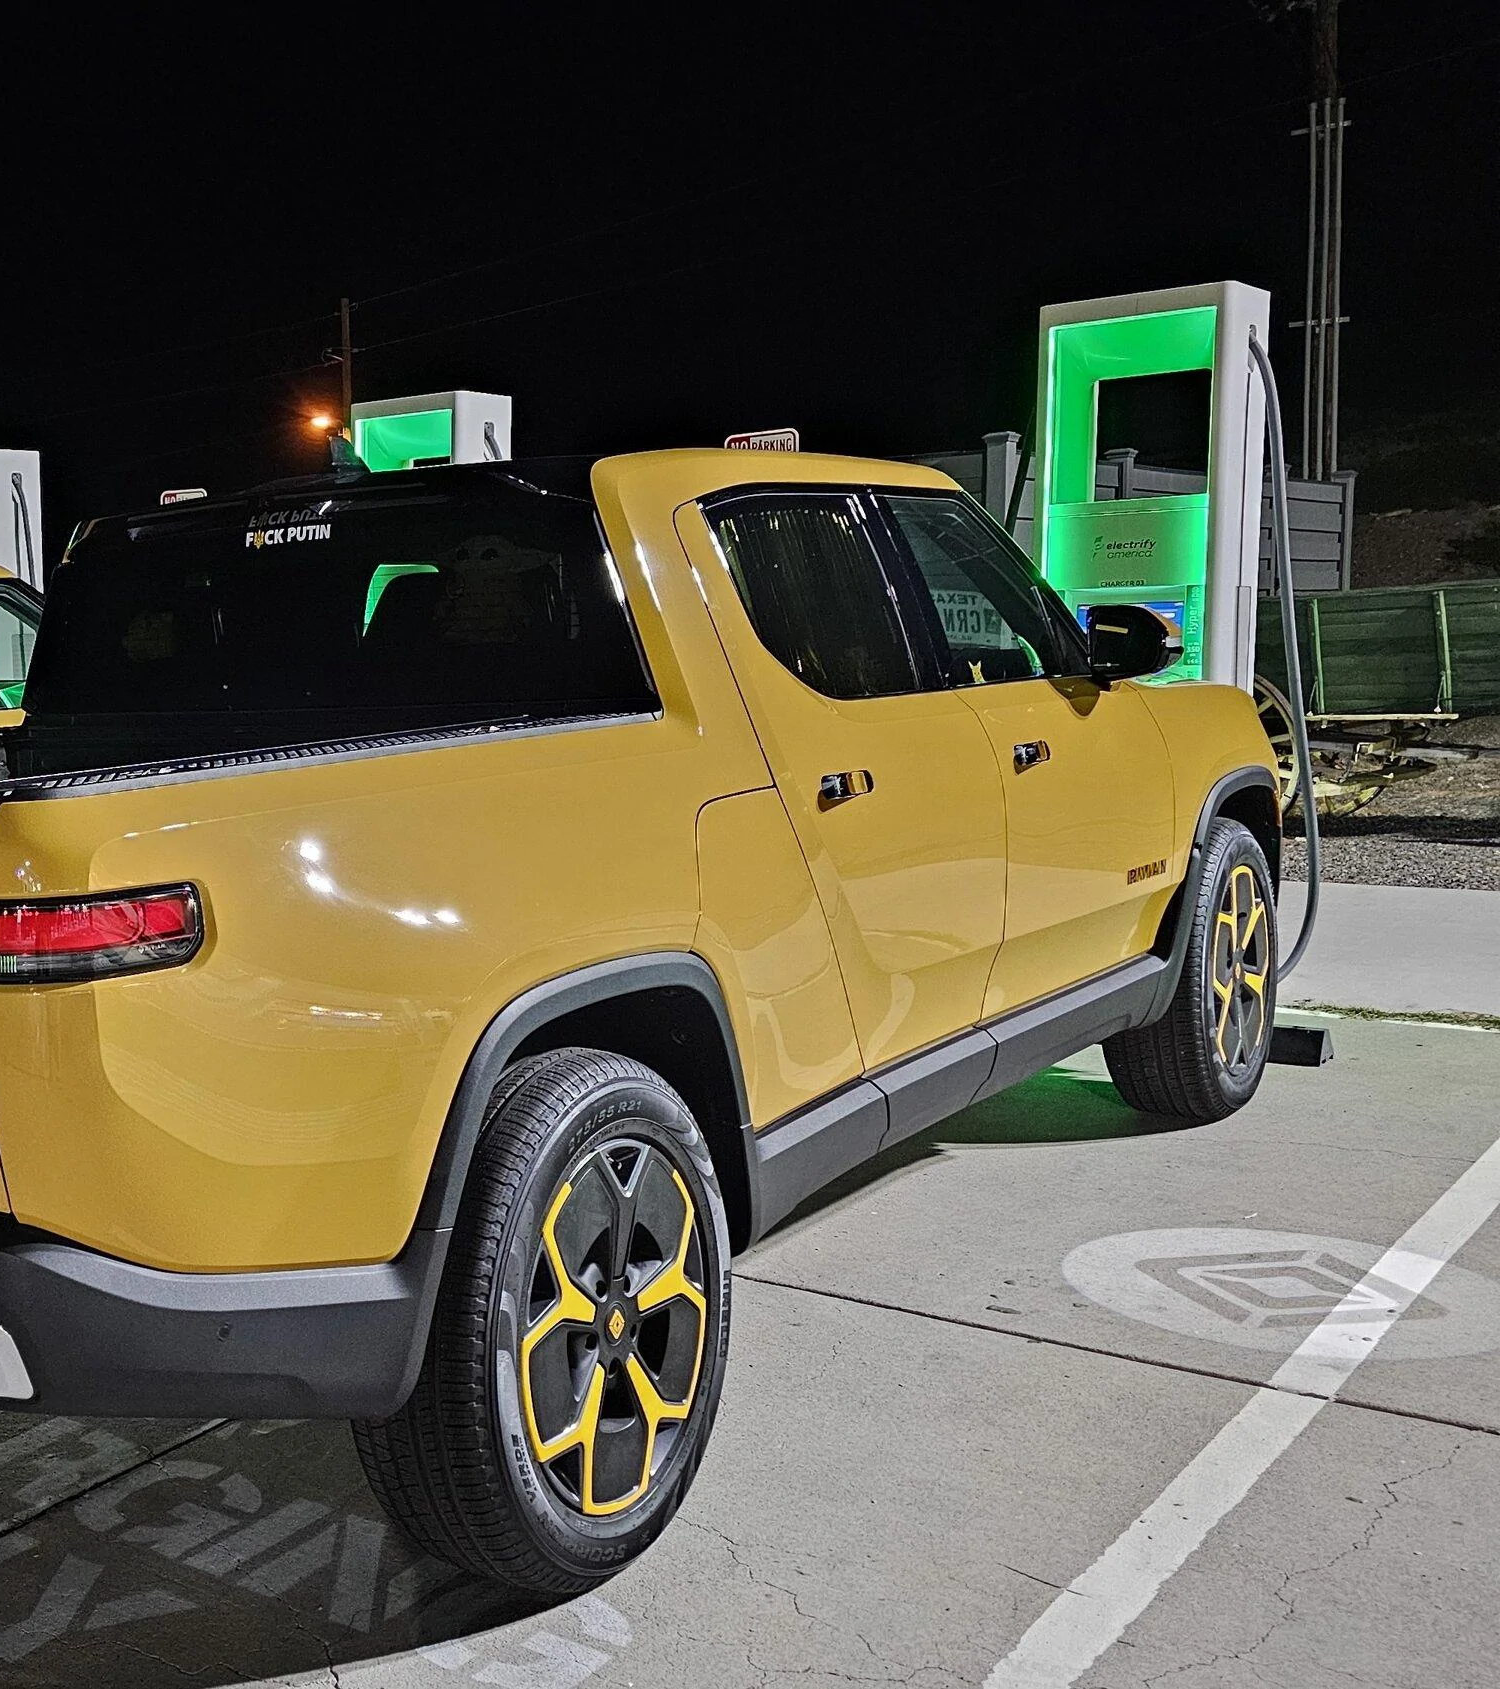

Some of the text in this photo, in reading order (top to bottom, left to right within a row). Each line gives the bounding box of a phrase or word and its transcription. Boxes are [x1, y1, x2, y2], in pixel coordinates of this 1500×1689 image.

[752, 438, 792, 452] PARKING
[287, 524, 332, 543] PUTIN
[1106, 539, 1156, 550] electrify
[1126, 858, 1167, 886] RIVIAN
[510, 1433, 538, 1504] VERDE
